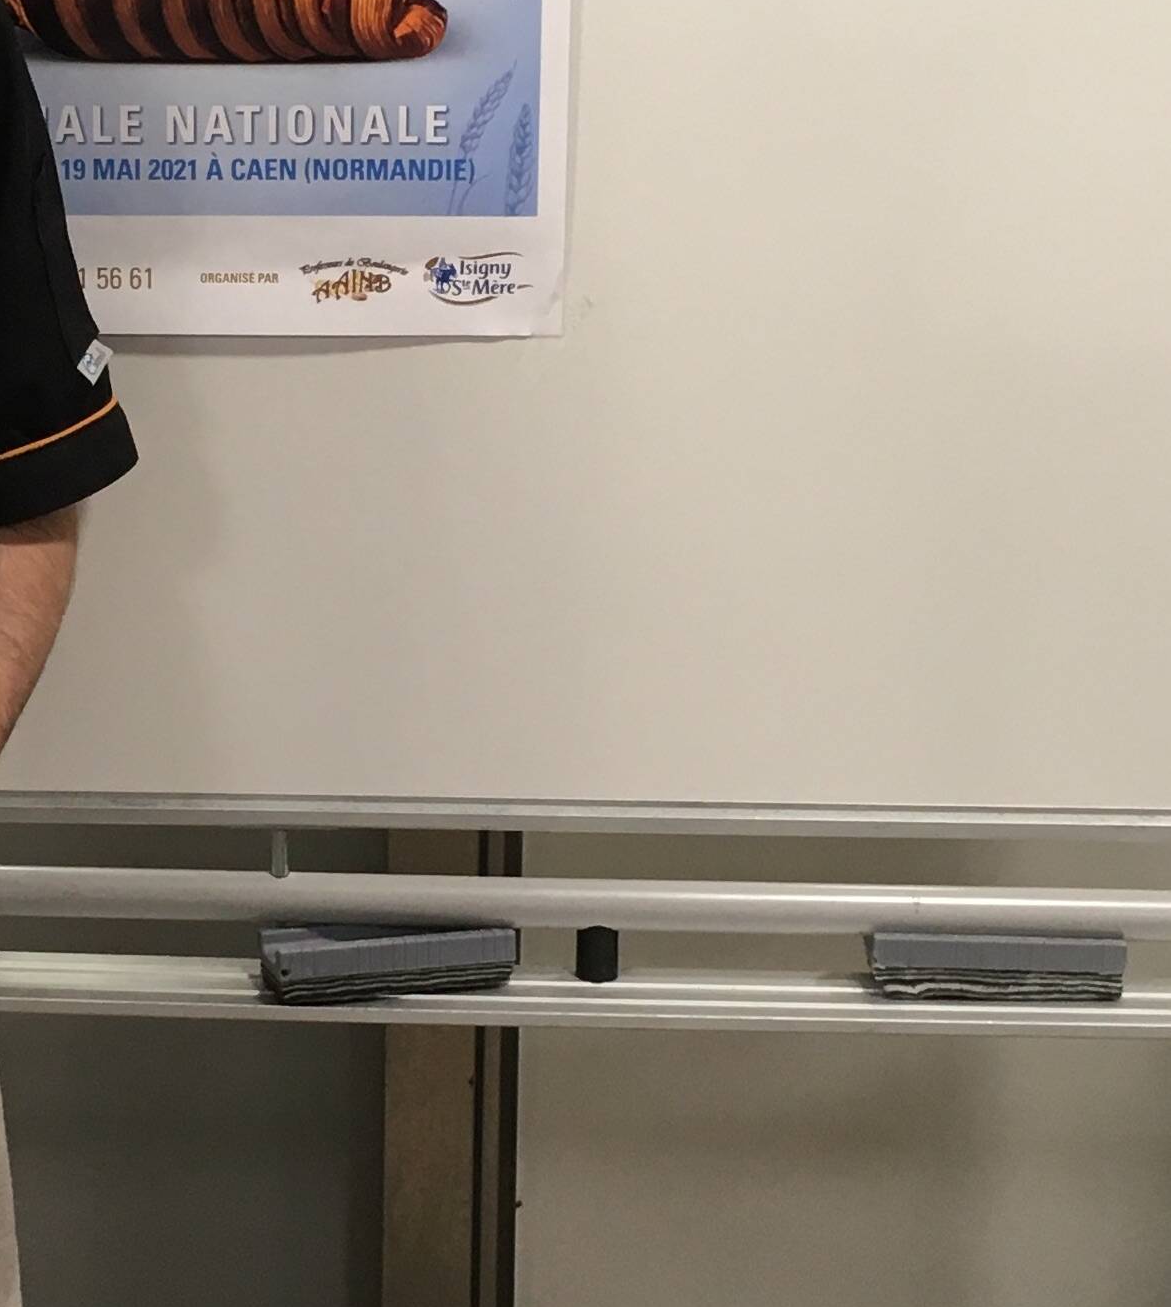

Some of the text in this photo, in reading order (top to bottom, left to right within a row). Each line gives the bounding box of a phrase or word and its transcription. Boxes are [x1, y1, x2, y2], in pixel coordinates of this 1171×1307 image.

[42, 102, 451, 146] ALE NATIONALE
[61, 151, 476, 184] 19 MAI 2021 À CAEN (NORMANDIE)
[96, 267, 122, 290] 56
[129, 267, 153, 290] 61
[257, 272, 279, 284] PAR
[459, 260, 512, 278] Isigny
[472, 278, 516, 295] Mère
